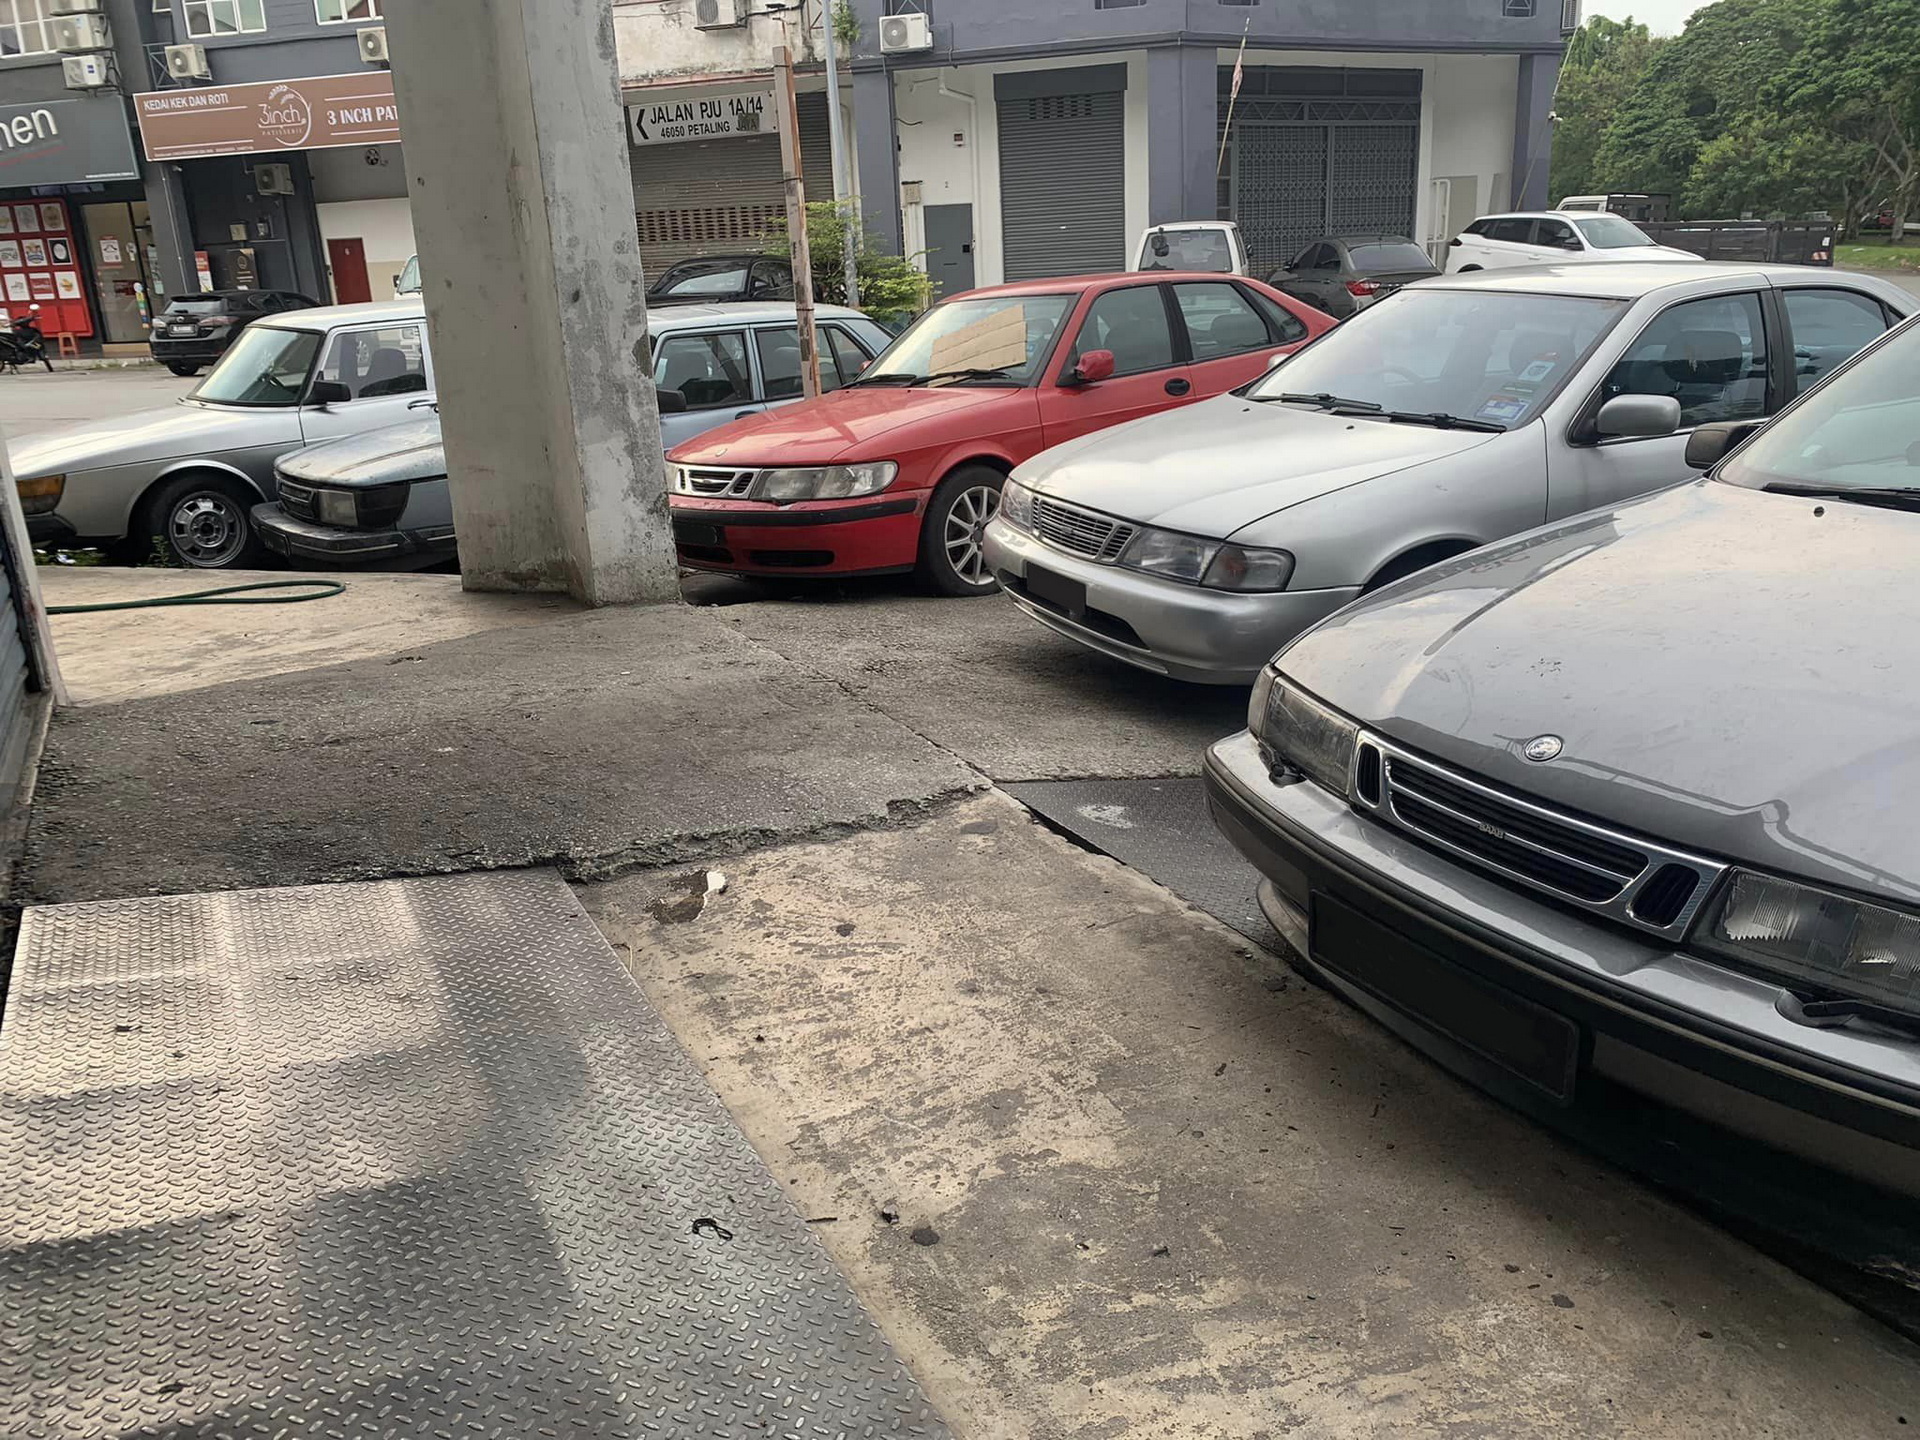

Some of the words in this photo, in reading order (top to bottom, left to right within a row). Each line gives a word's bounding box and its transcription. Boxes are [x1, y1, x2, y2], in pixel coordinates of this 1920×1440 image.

[143, 99, 169, 110] KEDAI
[170, 97, 189, 108] KEK
[189, 95, 207, 106] DAN
[208, 93, 228, 105] ROTI
[650, 103, 694, 124] JALAN
[700, 99, 722, 119] PJU
[729, 95, 764, 115] 1A/14
[258, 103, 301, 125] 3inch
[326, 110, 337, 125] 3
[340, 107, 373, 124] INCH
[660, 127, 685, 139] 46050
[688, 120, 730, 135] PETALING
